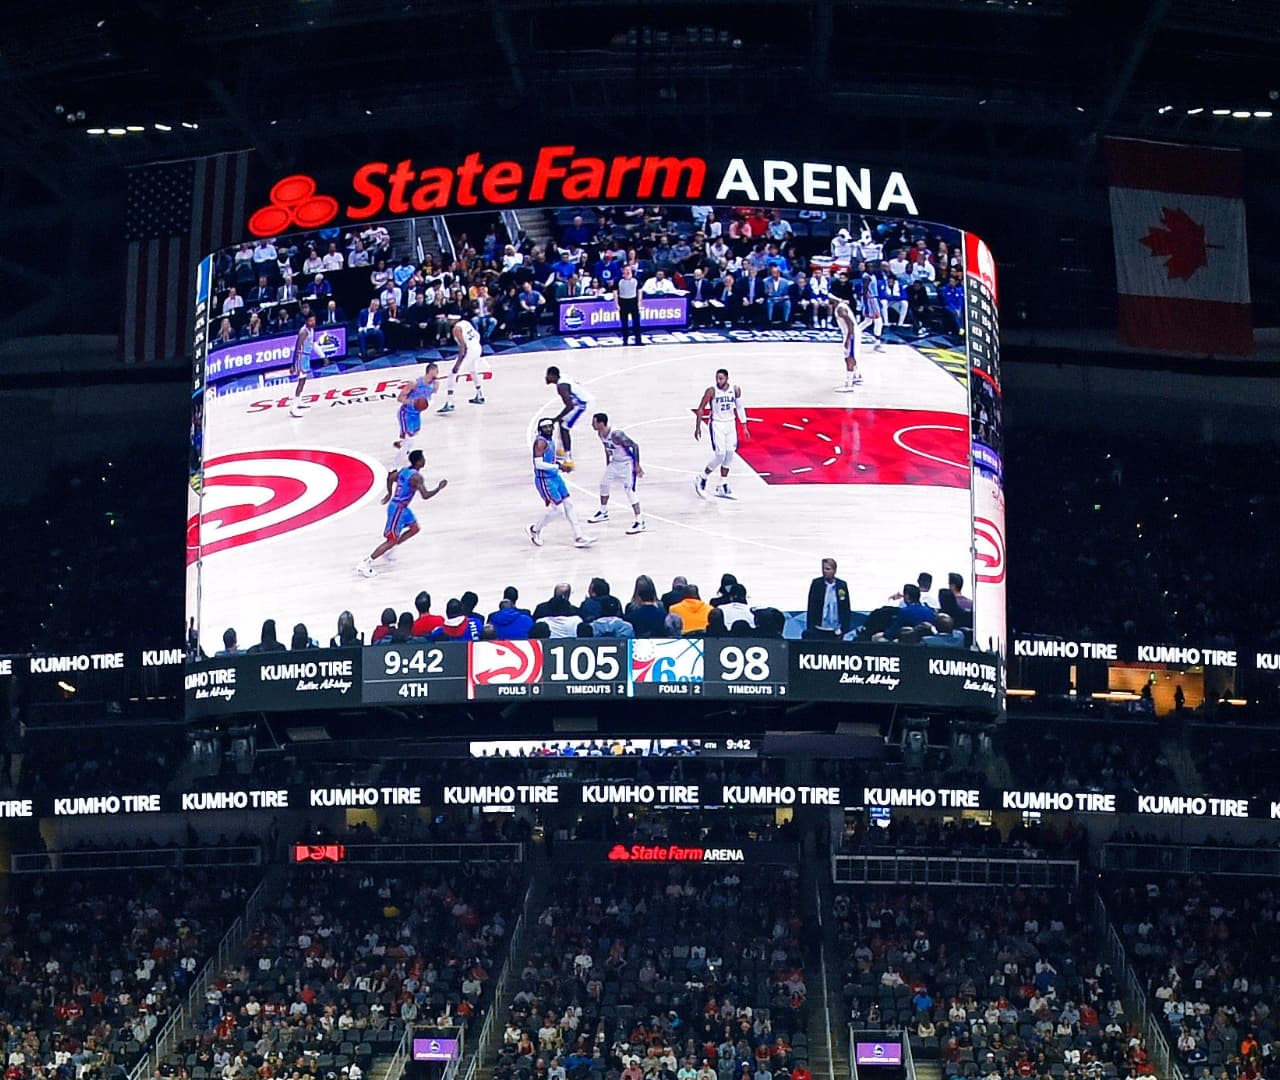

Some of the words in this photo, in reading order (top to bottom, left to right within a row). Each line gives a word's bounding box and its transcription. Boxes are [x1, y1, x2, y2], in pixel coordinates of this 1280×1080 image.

[346, 152, 524, 219] State
[527, 144, 708, 203] Farm
[715, 158, 919, 215] ARENA
[591, 308, 620, 326] plan
[225, 351, 252, 370] free
[256, 345, 290, 363] zone
[330, 392, 397, 408] AREN
[31, 655, 89, 673] KUMHO
[91, 653, 123, 669] TIRE
[383, 649, 444, 675] 9:42
[550, 647, 620, 681] 105
[720, 646, 770, 681] 98
[1138, 646, 1200, 664] KUMHO
[1202, 650, 1237, 666] TIRE
[208, 669, 236, 684] TIRE
[398, 683, 429, 698] 4TH
[498, 685, 526, 696] FOULS
[532, 685, 540, 696] 0
[566, 685, 611, 696] TIMEOUTS
[617, 685, 624, 695] 2
[658, 685, 688, 694] FOULS
[693, 685, 701, 694] 2
[728, 685, 772, 696] TIMEOUTS
[778, 686, 786, 696] 3
[726, 739, 751, 750] 9:42
[183, 792, 247, 810] KUMHO
[250, 790, 288, 807] TIRE
[311, 788, 378, 806] KUMHO
[381, 788, 420, 804] TIRE
[723, 787, 795, 804] KUMHO
[798, 787, 840, 804] TIRE
[864, 788, 935, 806] KUMHO
[938, 789, 979, 807] TIRE
[1003, 791, 1073, 810] KUMHO
[1076, 794, 1115, 811] TIRE
[631, 845, 666, 860] State
[668, 846, 703, 860] Farm
[704, 849, 744, 861] ARENA
